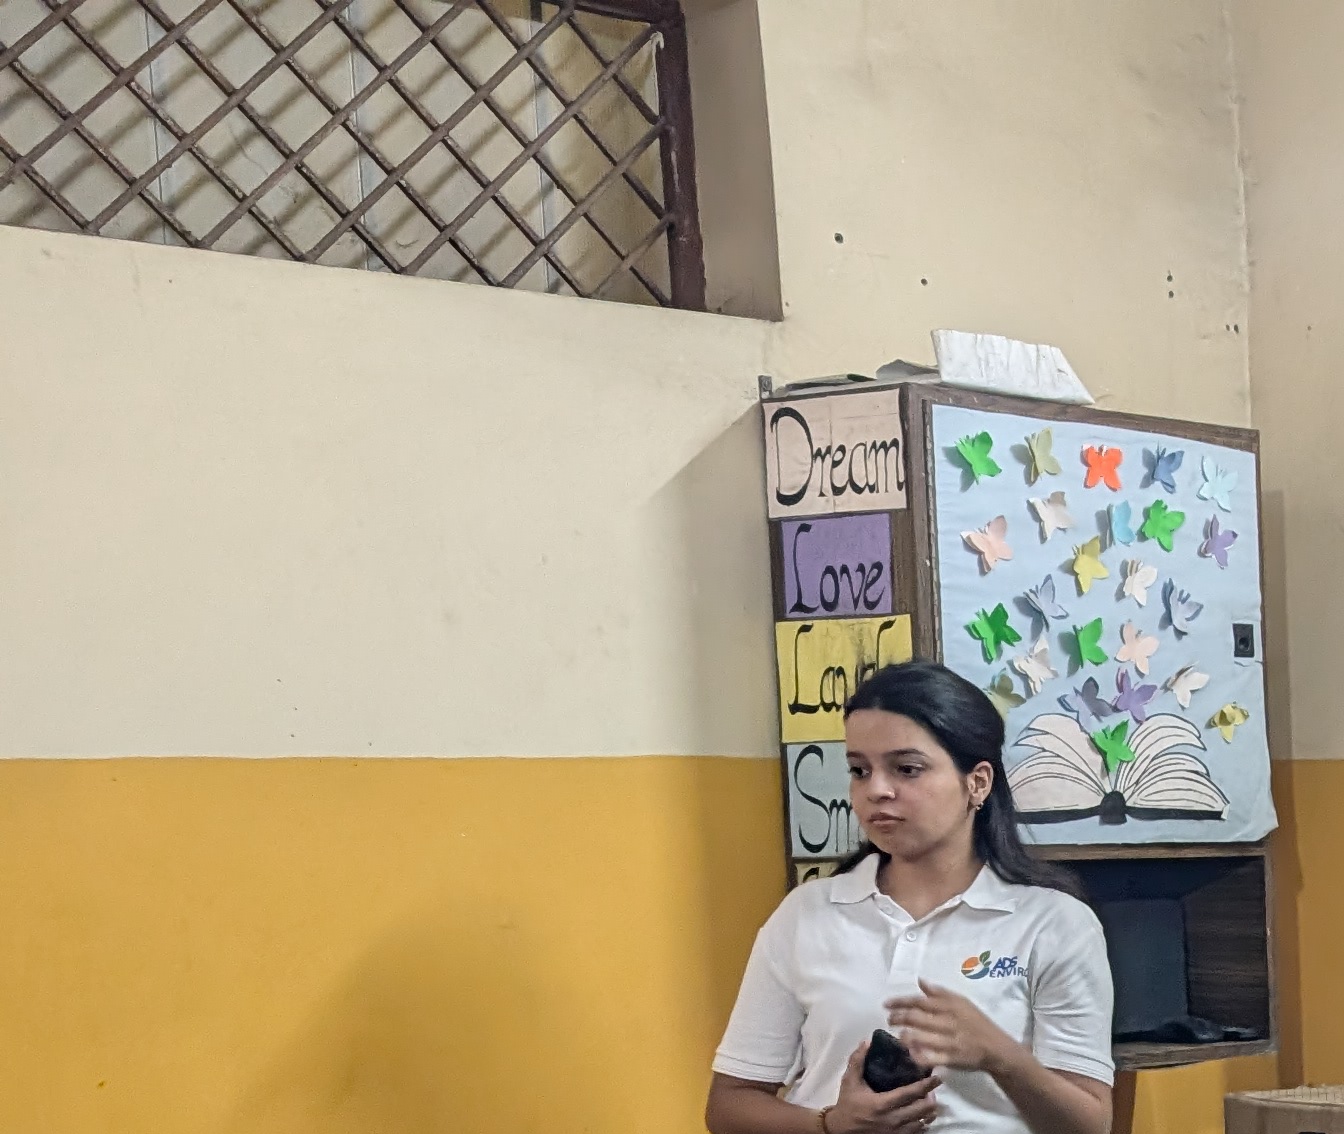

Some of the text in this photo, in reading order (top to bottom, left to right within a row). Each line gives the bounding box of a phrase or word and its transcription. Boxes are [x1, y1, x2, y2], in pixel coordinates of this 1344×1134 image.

[770, 407, 905, 506] Dream
[789, 523, 885, 614] Love
[993, 956, 1018, 970] ADS
